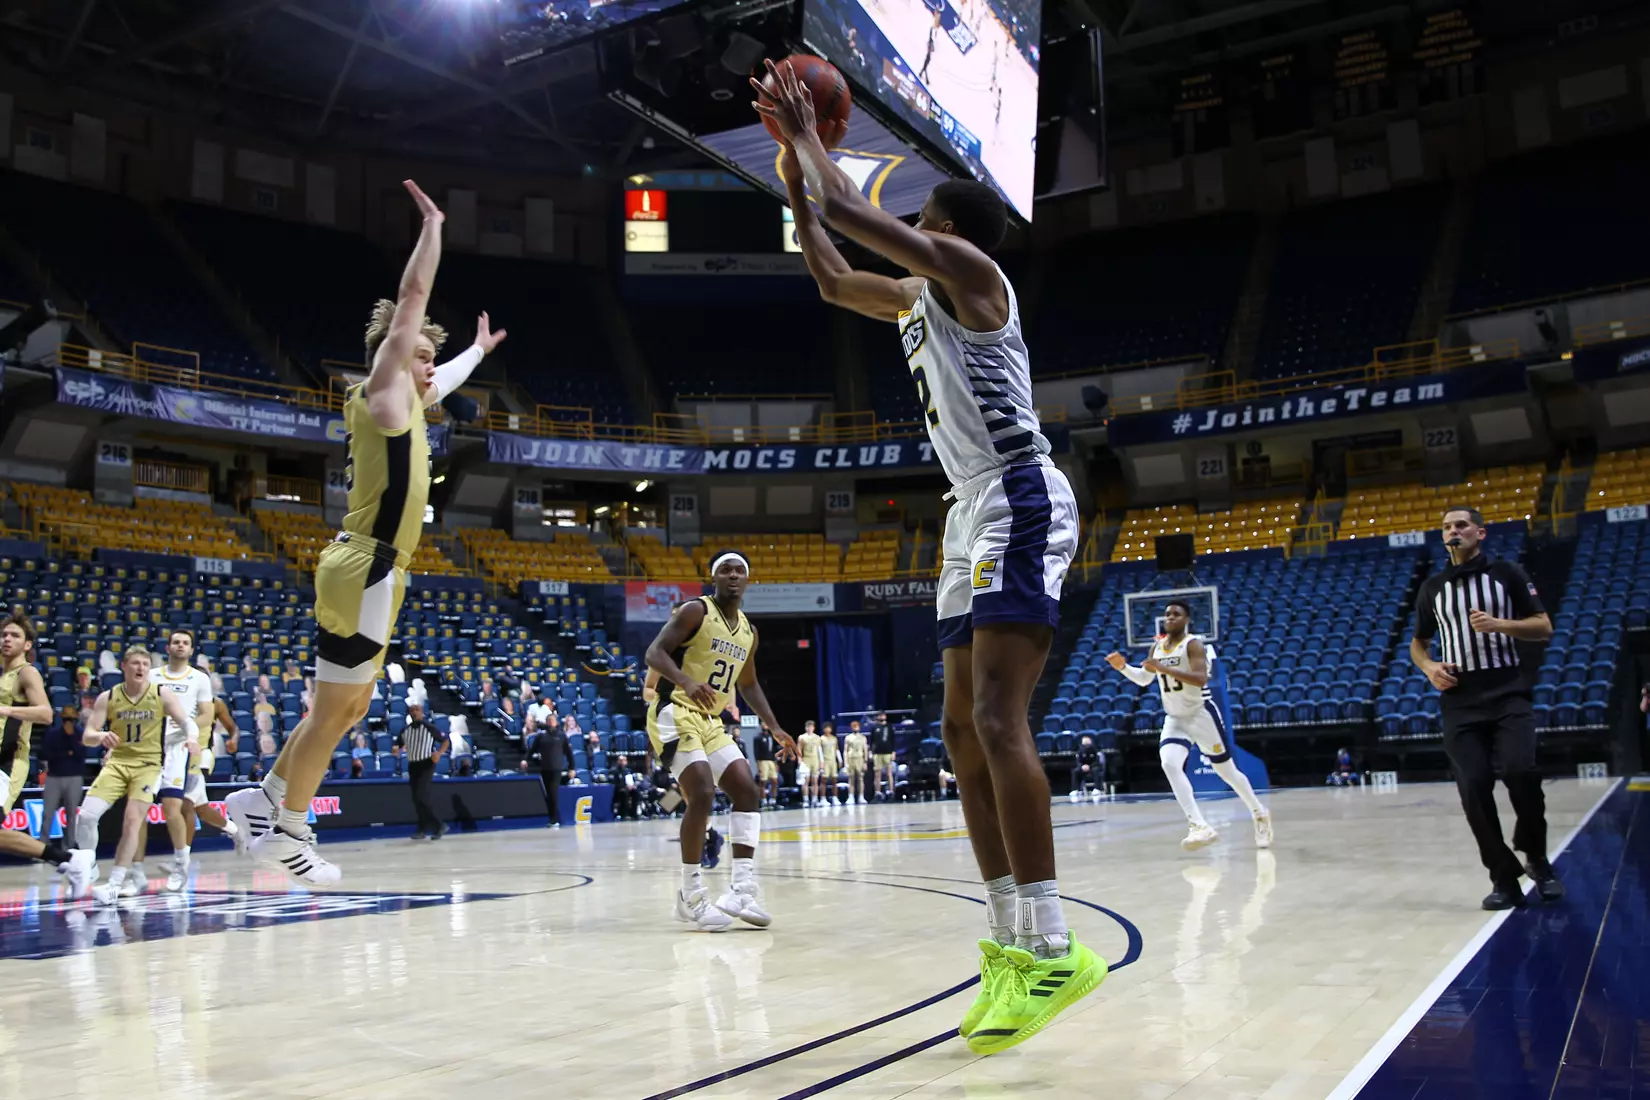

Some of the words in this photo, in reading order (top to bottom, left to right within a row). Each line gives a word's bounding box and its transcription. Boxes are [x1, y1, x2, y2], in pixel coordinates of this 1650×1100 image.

[229, 416, 249, 430] TV
[252, 419, 297, 436] Partner
[298, 413, 321, 428] And
[1426, 430, 1456, 448] 222
[102, 444, 129, 463] 216
[522, 441, 604, 465] JOIN
[619, 447, 687, 469] THE
[702, 450, 797, 470] MOCS
[814, 444, 902, 468] CLUB
[1200, 459, 1223, 475] 221
[1613, 507, 1639, 519] 122
[203, 560, 225, 573] 115
[545, 582, 566, 593] 117
[864, 583, 905, 600] RUBY
[710, 637, 748, 662] WOFFORD
[708, 658, 735, 694] 21
[1161, 673, 1184, 693] 13
[116, 709, 156, 720] WOFFORD
[125, 722, 142, 743] 11
[311, 797, 342, 815] CITY
